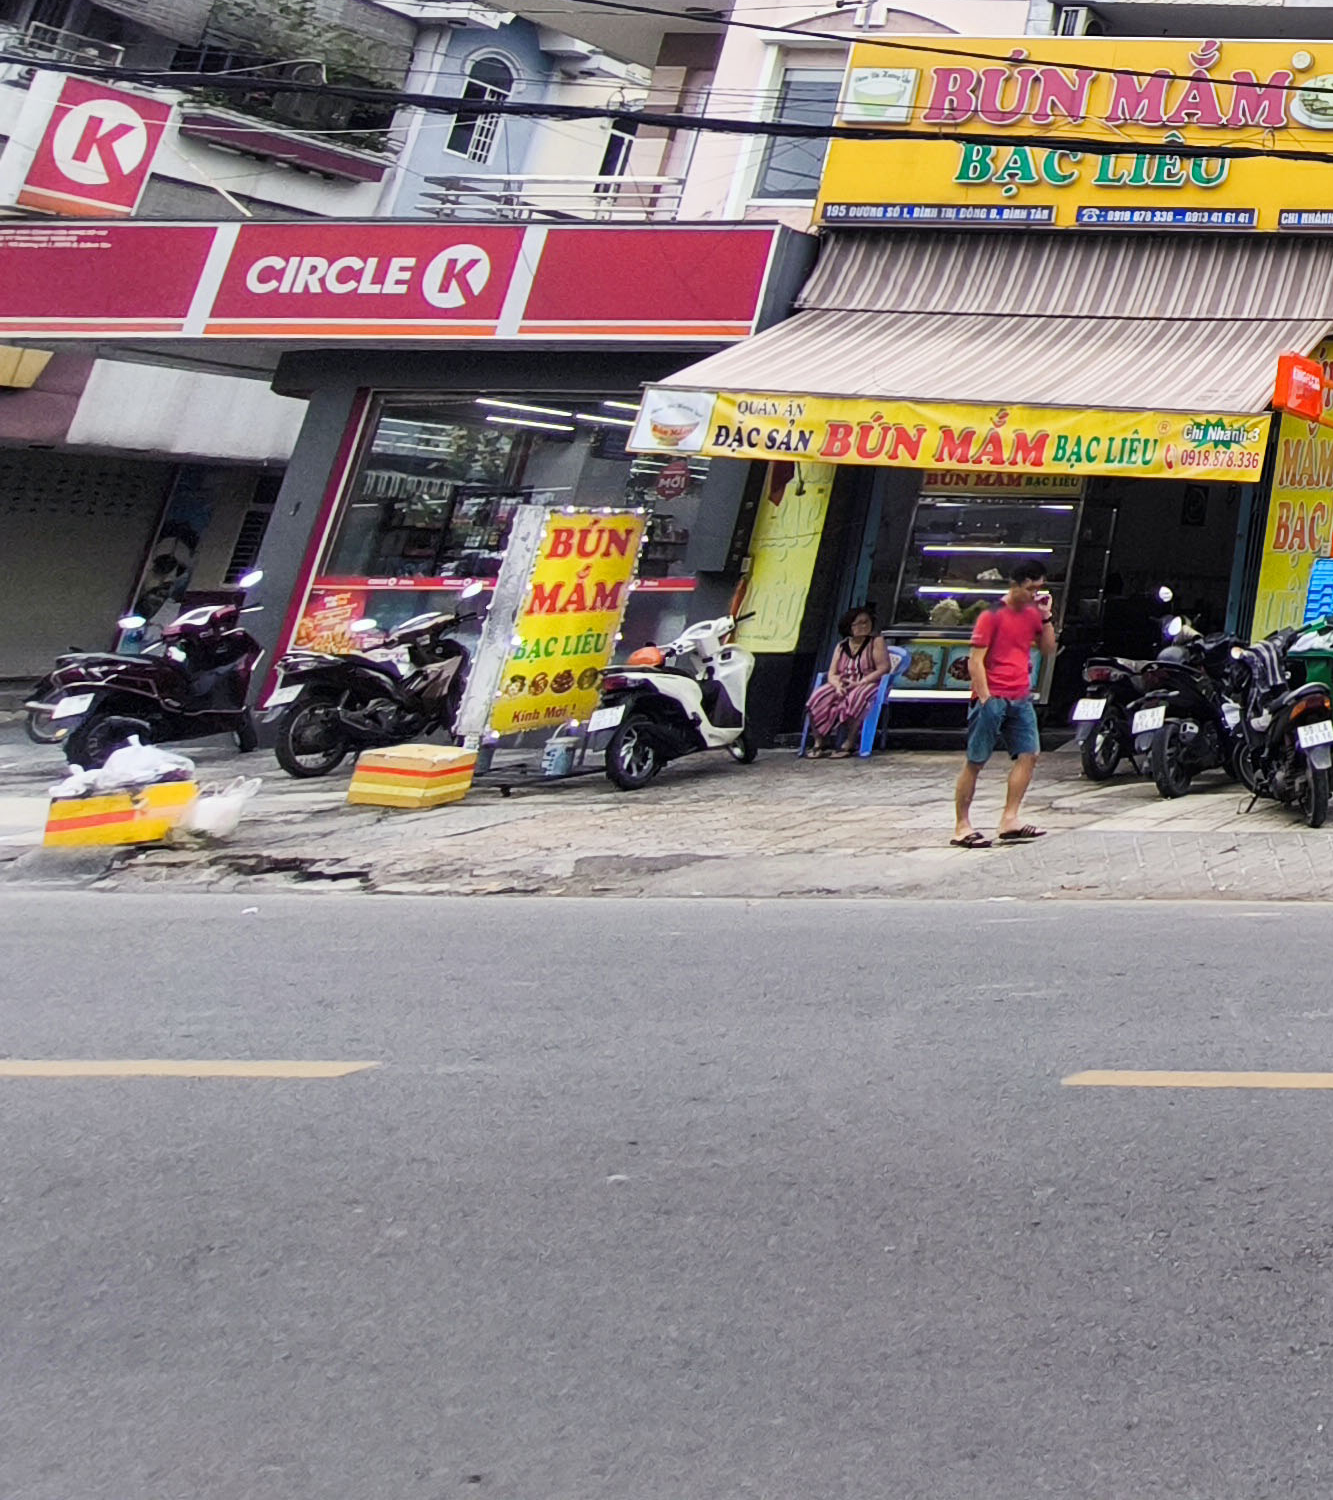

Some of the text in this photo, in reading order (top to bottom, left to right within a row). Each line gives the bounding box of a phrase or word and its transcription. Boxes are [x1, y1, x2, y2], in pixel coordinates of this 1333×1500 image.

[921, 40, 1294, 128] BÚN MẮM
[954, 132, 1230, 198] BẠC LIÊU
[246, 256, 416, 294] CIRCLE
[712, 408, 1159, 469] ĐẶC SẢN BÚN MẮM BẠC LIÊU
[1182, 422, 1203, 440] Chi
[1180, 448, 1260, 470] 0918.878.336
[544, 518, 634, 561] BÚN
[524, 564, 626, 616] MẮM
[558, 628, 609, 657] LIÊU
